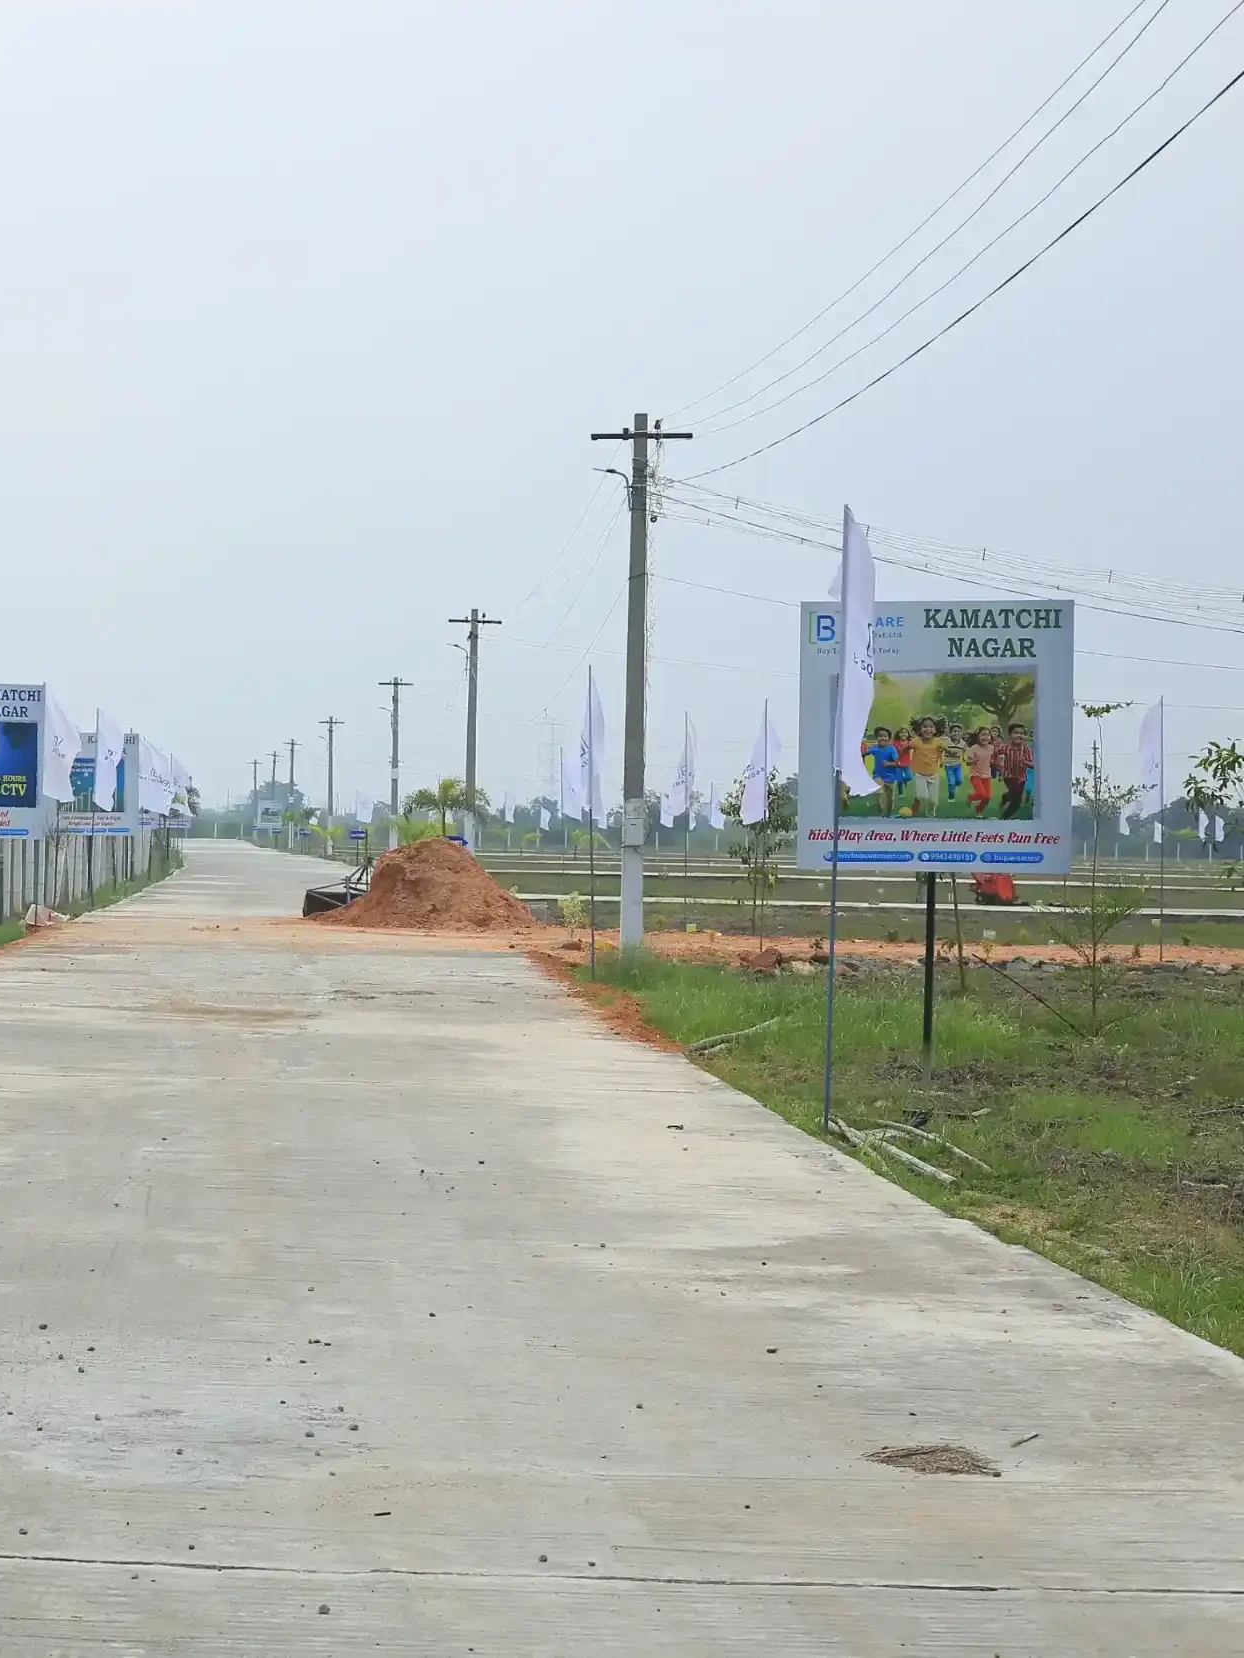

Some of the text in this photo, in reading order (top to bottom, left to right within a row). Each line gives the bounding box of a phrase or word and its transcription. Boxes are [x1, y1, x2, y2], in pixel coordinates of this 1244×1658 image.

[923, 608, 1062, 629] KAMATCHI
[947, 637, 1036, 658] NAGAR
[3, 775, 27, 783] HOURS
[808, 829, 834, 840] Kids
[837, 829, 863, 843] Play
[900, 830, 939, 842] Where
[941, 830, 973, 843] Little
[975, 831, 1004, 843] Feets
[1007, 832, 1031, 844] Run
[1034, 832, 1060, 844] Free
